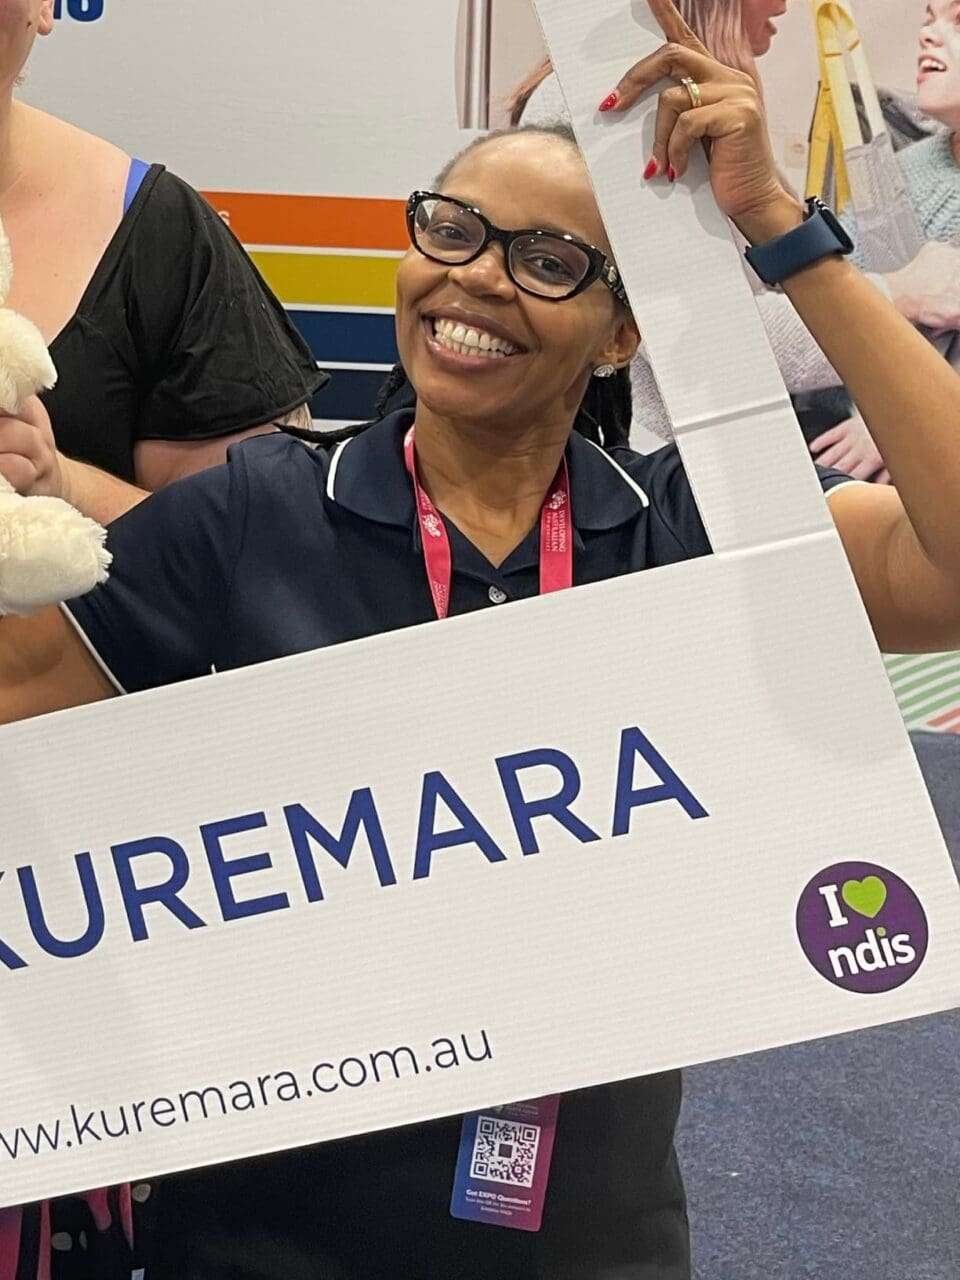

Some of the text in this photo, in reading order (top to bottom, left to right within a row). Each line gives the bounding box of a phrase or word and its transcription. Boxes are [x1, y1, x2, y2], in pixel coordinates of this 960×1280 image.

[819, 884, 848, 928] I
[828, 926, 916, 978] ndis
[479, 1190, 497, 1201] EXPO
